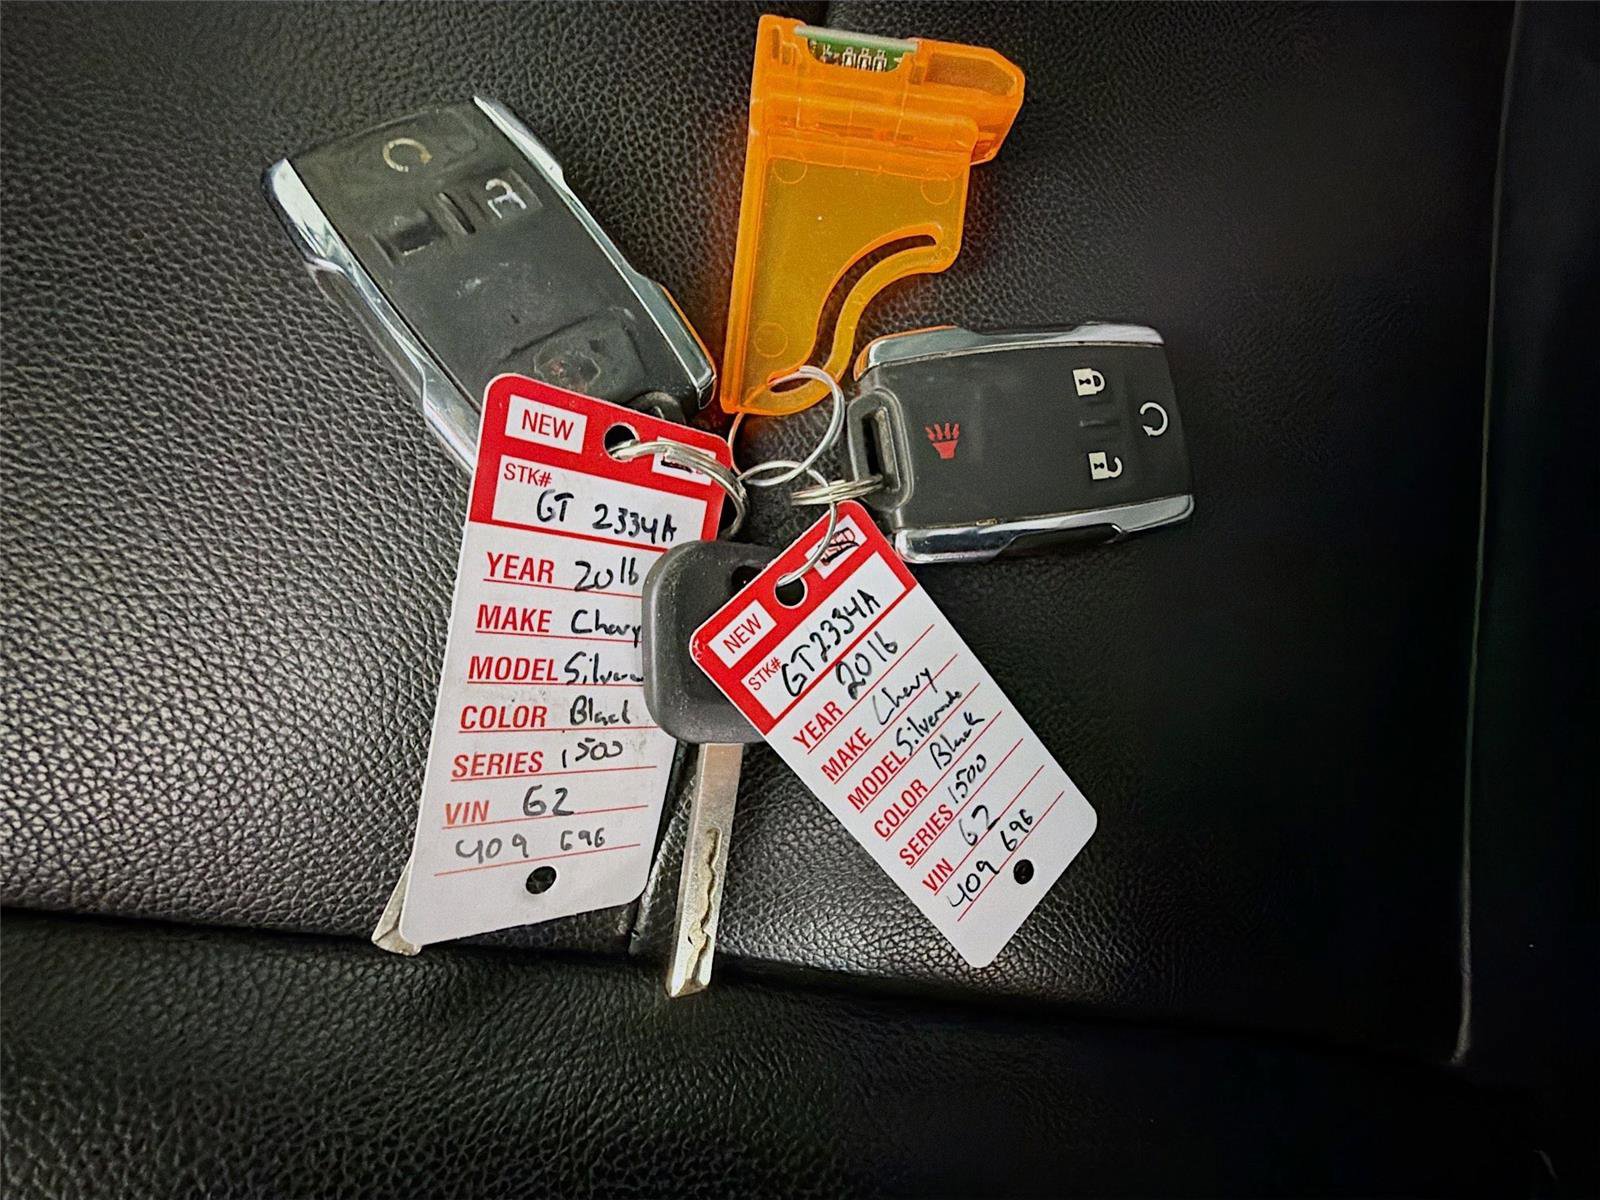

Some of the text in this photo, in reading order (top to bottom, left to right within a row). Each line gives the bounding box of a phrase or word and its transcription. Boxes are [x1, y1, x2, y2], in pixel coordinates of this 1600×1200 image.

[521, 409, 574, 441] NEW
[503, 463, 552, 486] STK#
[536, 489, 575, 523] GT
[486, 552, 640, 592] YEAR 2016
[476, 604, 552, 633] MAKE
[722, 613, 762, 654] NEW
[468, 656, 558, 681] MODEL
[749, 657, 782, 691] STK#
[793, 631, 899, 749] YEAR 2016
[460, 705, 548, 730] COLOR
[821, 667, 938, 781] MAKE Chevy
[452, 737, 623, 778] SERIES 1500
[847, 750, 907, 810] MODEL
[445, 800, 490, 825] VIN
[873, 778, 929, 838] COLOR
[899, 754, 987, 866] SERIES 1500
[455, 833, 529, 864] 409
[922, 858, 954, 891] VIN
[946, 860, 1000, 907] 409
